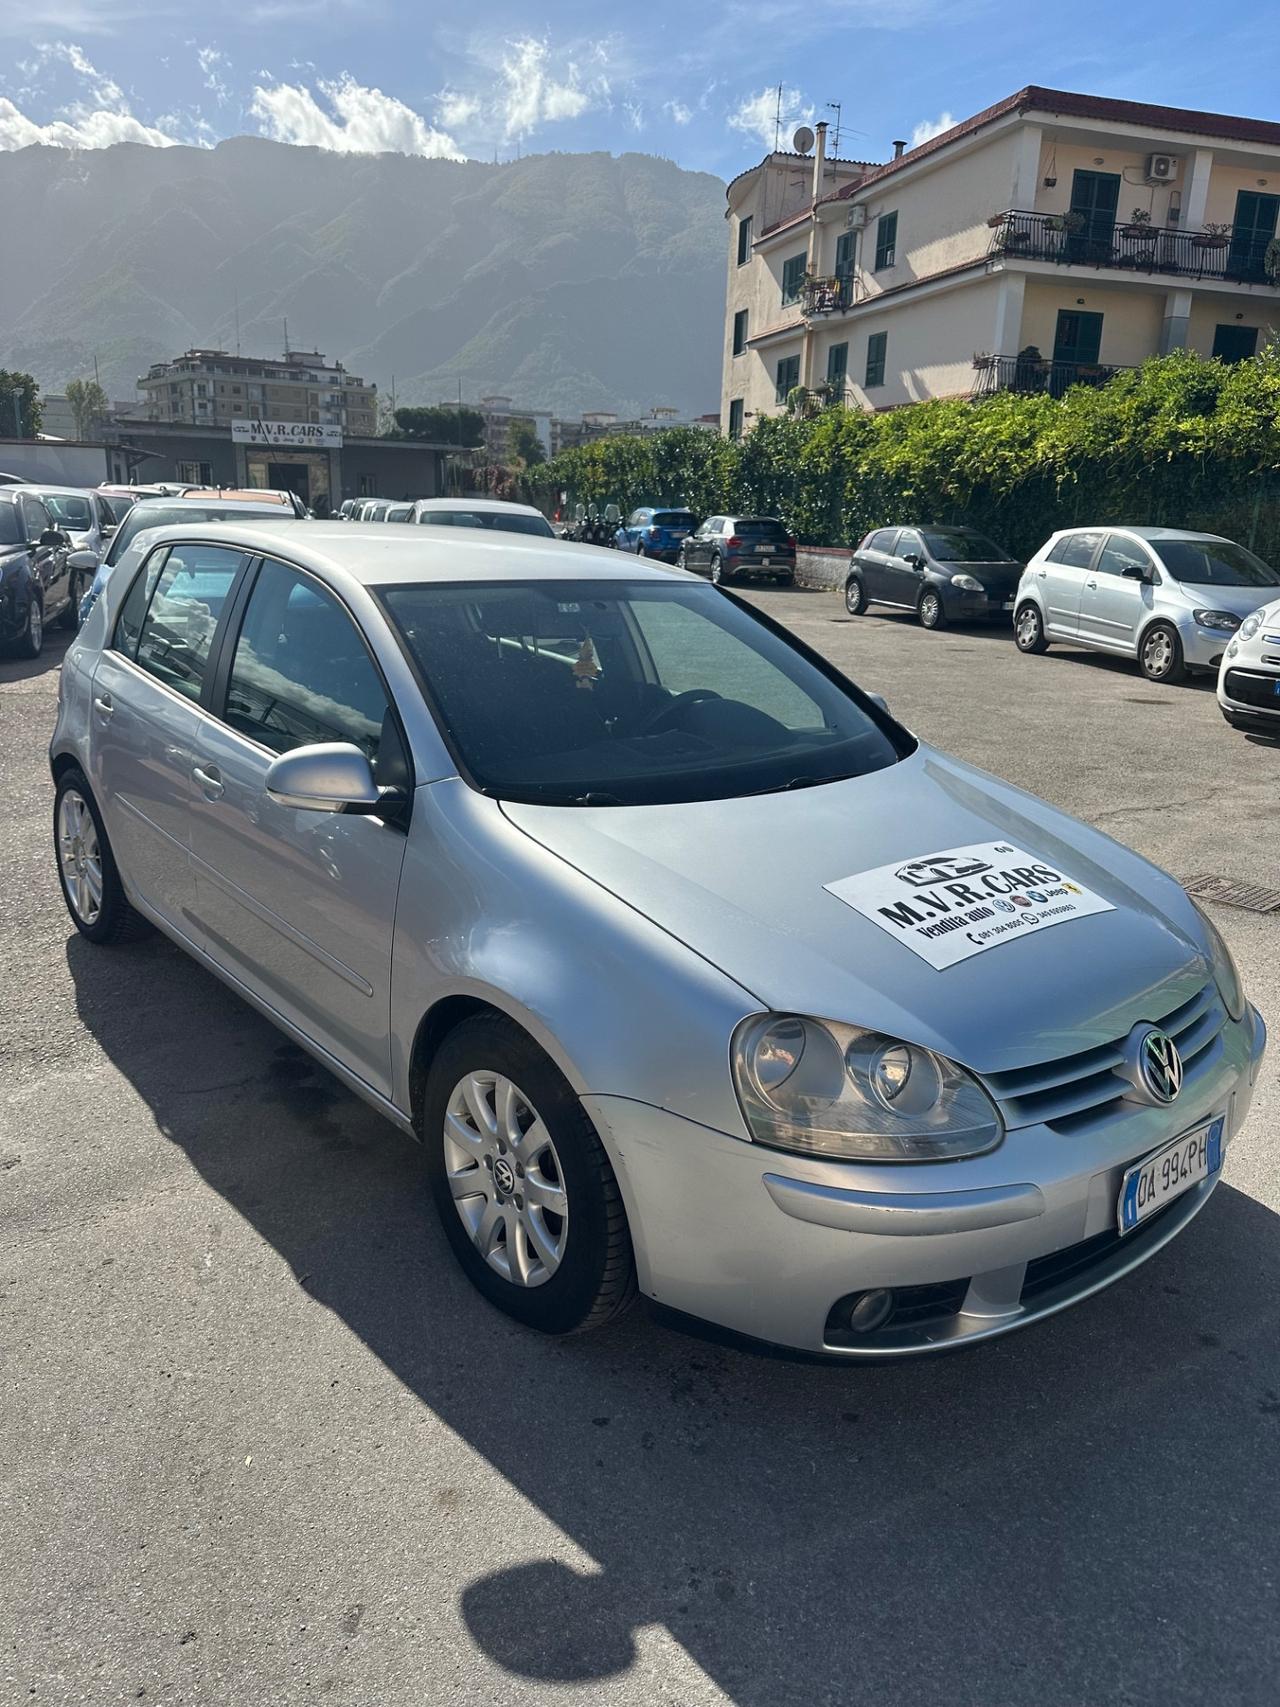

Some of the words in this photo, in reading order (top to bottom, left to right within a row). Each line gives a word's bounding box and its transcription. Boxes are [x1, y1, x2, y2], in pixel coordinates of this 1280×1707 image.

[877, 864, 1061, 929] M.V.R.CARS
[916, 912, 970, 939] Vendita
[964, 905, 995, 922] auto
